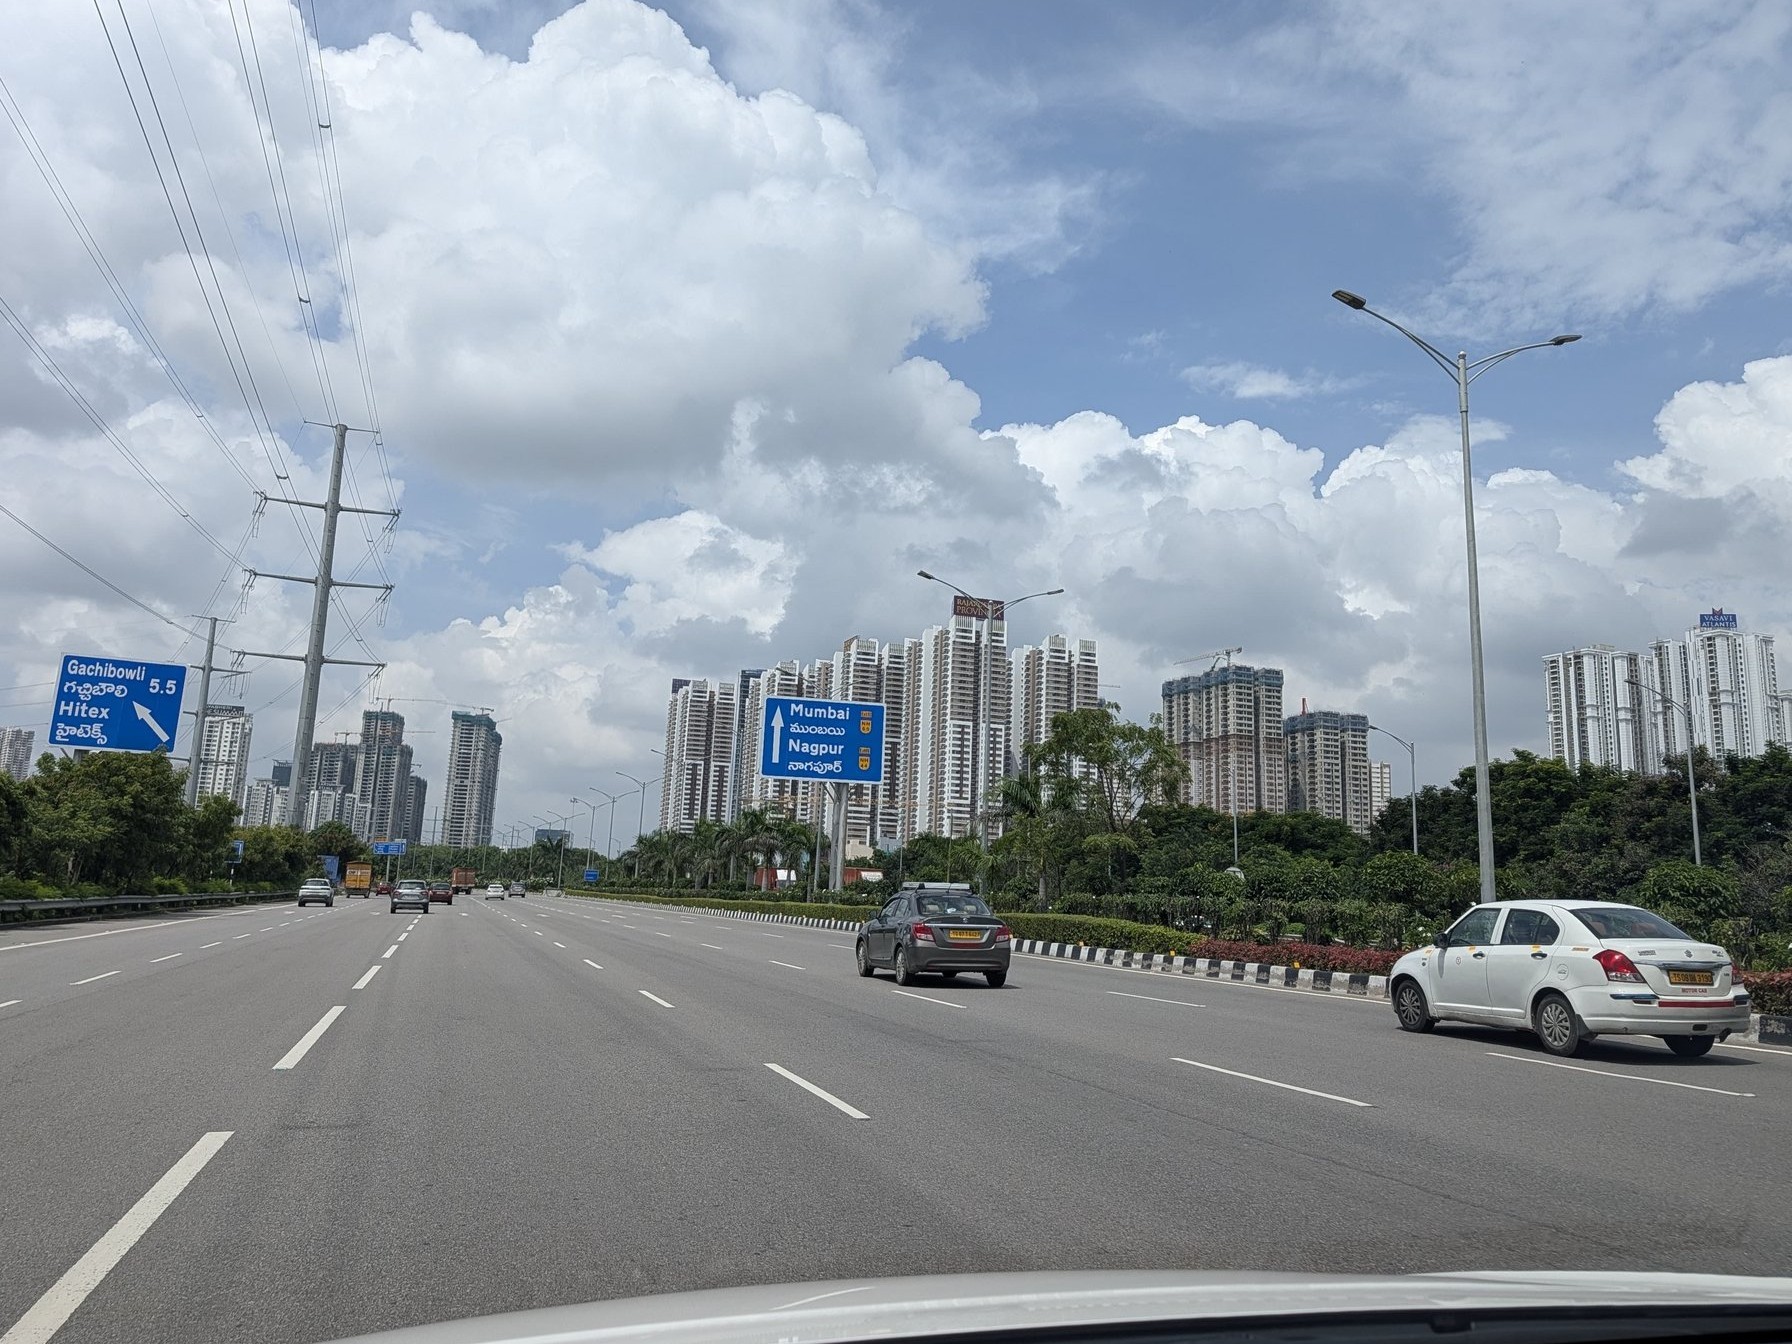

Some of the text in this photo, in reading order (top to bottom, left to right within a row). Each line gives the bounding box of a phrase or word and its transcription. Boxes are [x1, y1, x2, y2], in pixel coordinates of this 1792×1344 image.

[67, 660, 146, 681] Gachibowli
[63, 681, 128, 701] గచ్చిబౌలి
[149, 678, 177, 695] 5.5
[58, 701, 110, 719] Hitex
[790, 704, 849, 719] Mumbai
[55, 723, 108, 745] హైటెక్స్
[789, 723, 845, 736] ముంబయి
[788, 739, 844, 755] Nagpur
[788, 760, 842, 774] నాగపూర్
